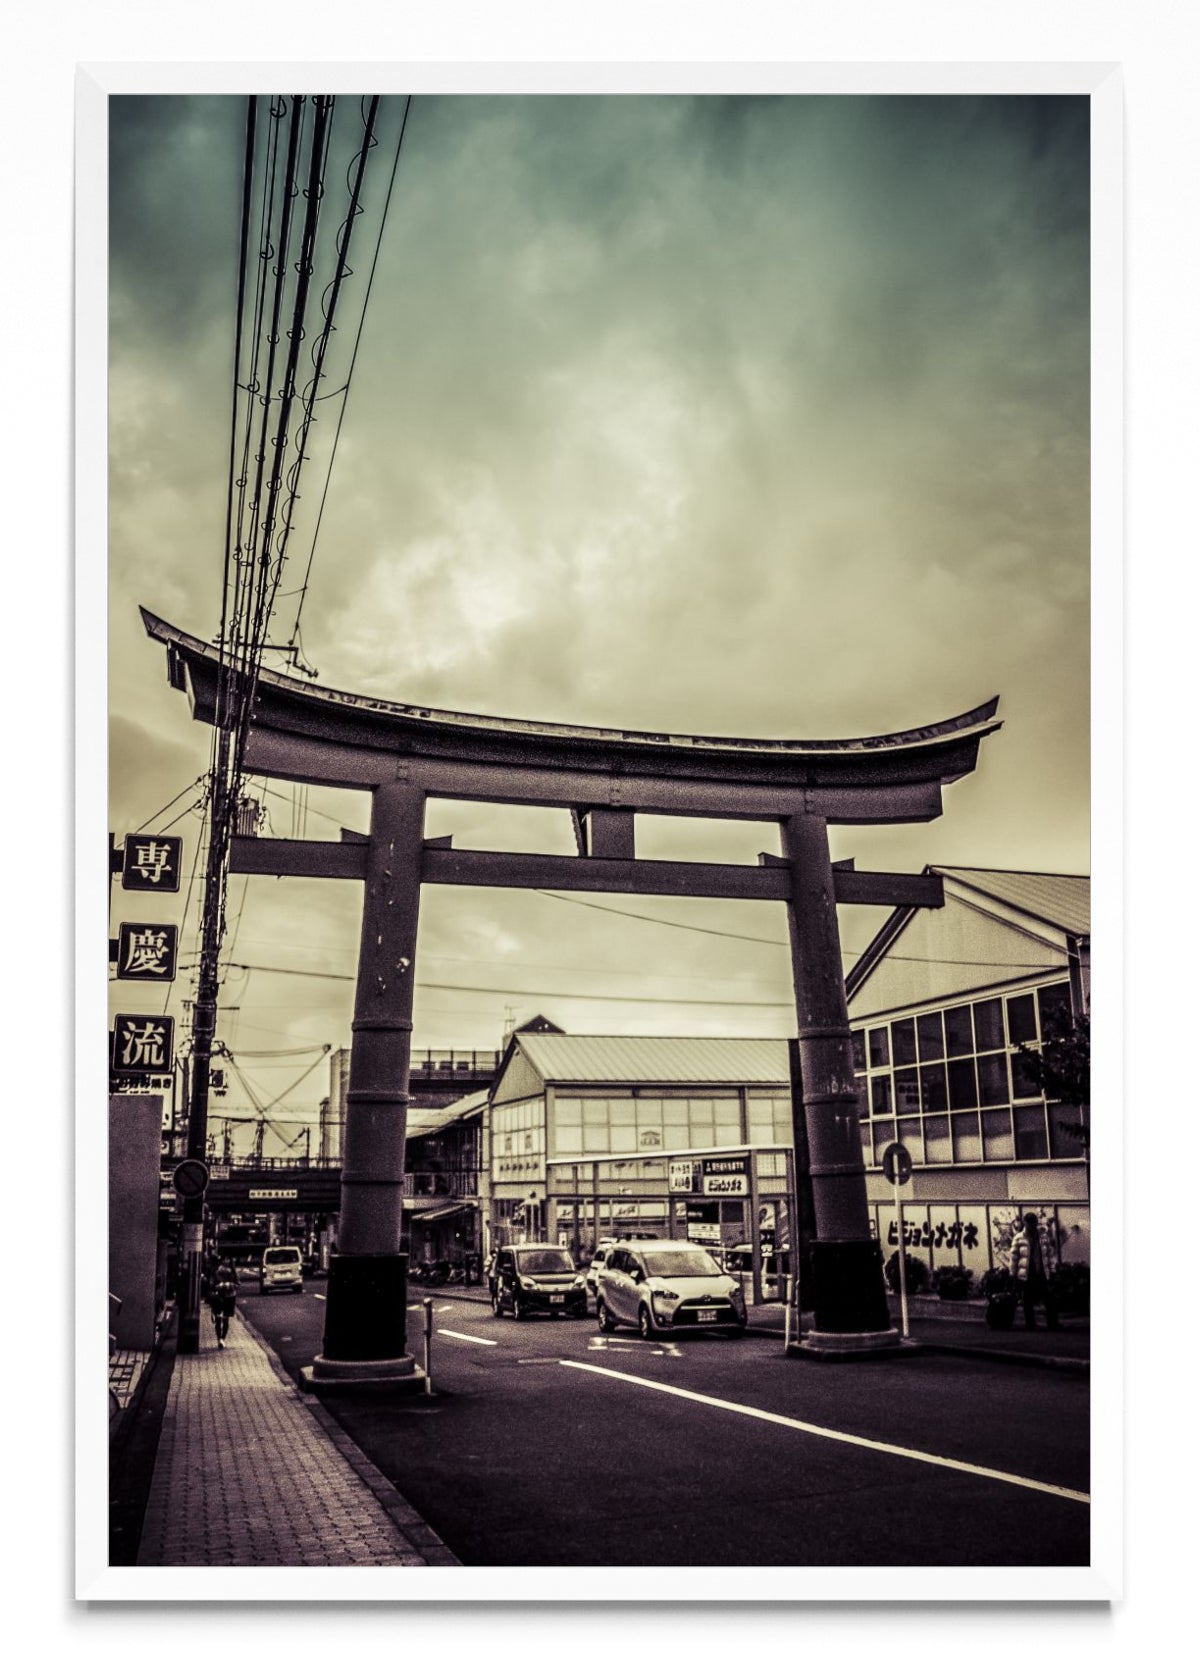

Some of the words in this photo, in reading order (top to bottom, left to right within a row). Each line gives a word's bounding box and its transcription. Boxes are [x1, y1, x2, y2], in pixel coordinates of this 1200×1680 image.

[122, 842, 171, 1066] 専慶流
[888, 1220, 979, 1250] ビジョンメガネ
